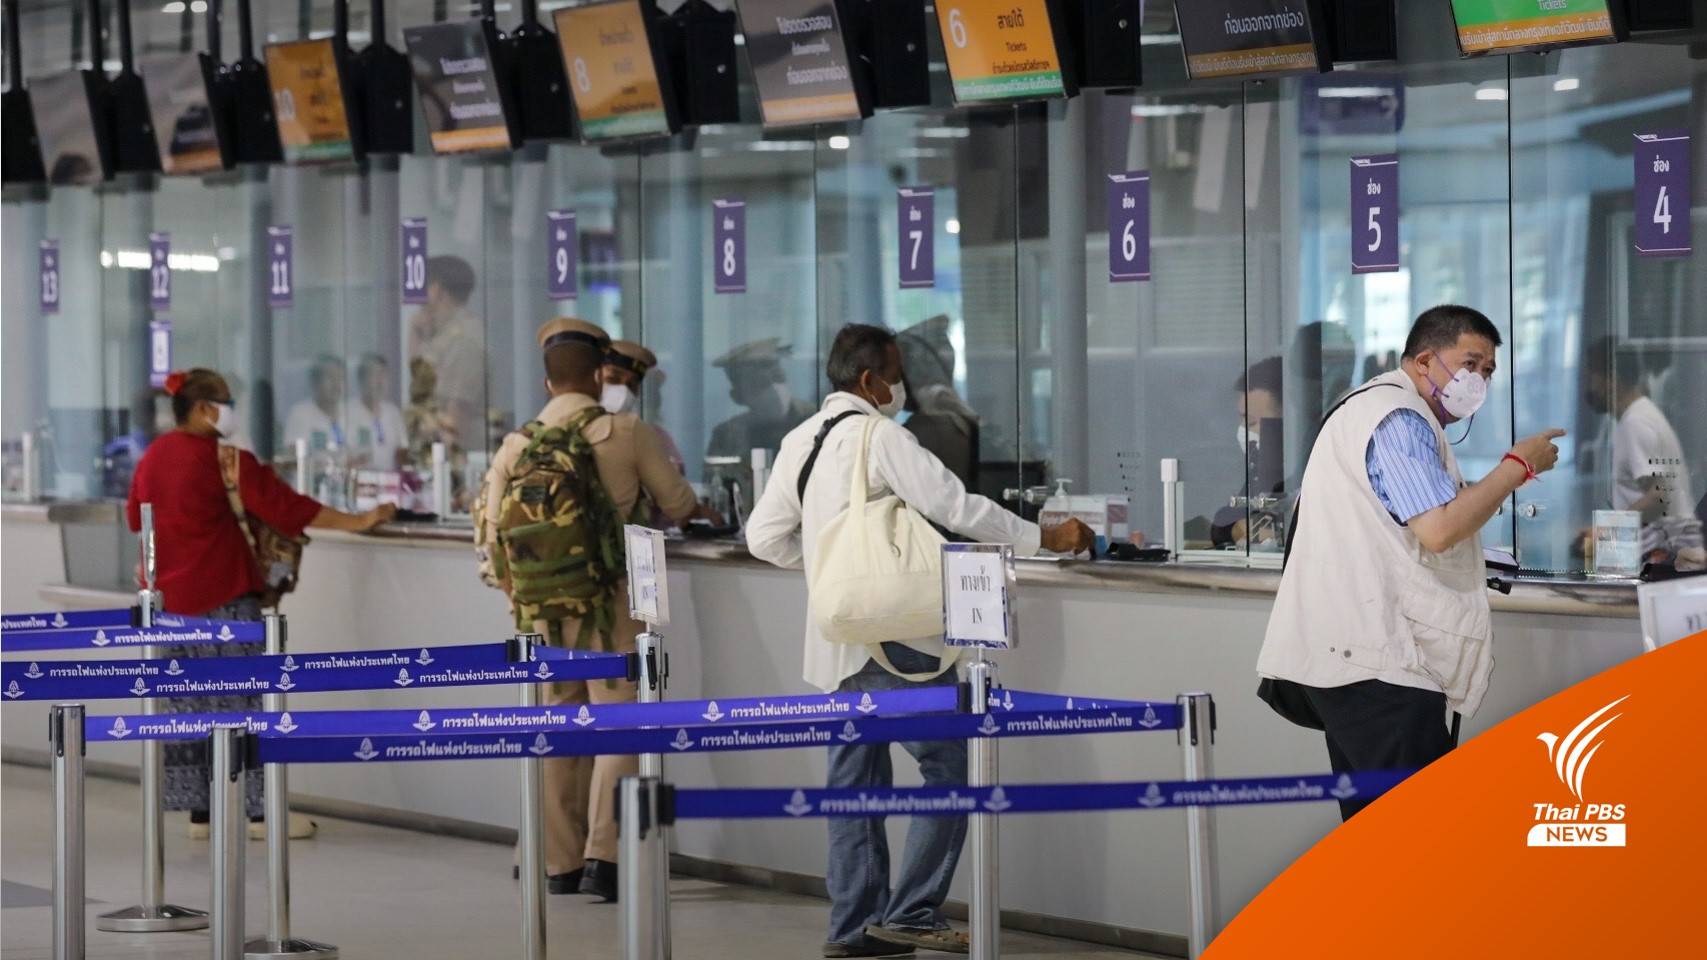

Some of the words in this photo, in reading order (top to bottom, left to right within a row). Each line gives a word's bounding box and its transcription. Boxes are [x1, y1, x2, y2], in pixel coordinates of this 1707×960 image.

[948, 8, 968, 49] 6
[997, 7, 1025, 29] สายใต้
[1224, 6, 1305, 35] ก่อนออกจากช่อง
[575, 57, 592, 94] 8
[1653, 154, 1670, 173] ช่อง
[1367, 177, 1382, 195] ช่อง
[1653, 186, 1672, 234] 4
[1368, 206, 1382, 252] 5
[909, 231, 923, 270] 7
[1122, 219, 1136, 262] 6
[556, 247, 568, 284] 9
[723, 238, 736, 277] 8
[152, 264, 169, 298] 12
[271, 260, 289, 294] 11
[405, 254, 425, 290] 10
[42, 269, 58, 303] 13
[972, 607, 984, 624] IN
[115, 628, 213, 644] การรถไฟแห่งประเทศไทย
[50, 663, 159, 678] การรถไฟแห่งประเทศไทย
[304, 653, 410, 670] การรถไฟแห่งประเทศไทย
[156, 677, 270, 693] การรถไฟแห่งประเทศไทย
[419, 666, 529, 683] การรถไฟแห่งประเทศไทย
[443, 710, 567, 728] การรถไฟแห่งประเทศไทย
[731, 699, 850, 718] การรถไฟแห่งประเทศไทย
[1007, 713, 1132, 731] การรถไฟแห่งประเทศไทย
[386, 738, 522, 757] การรถไฟแห่งประเทศไทย
[701, 726, 831, 747] การรถไฟแห่งประเทศไทย
